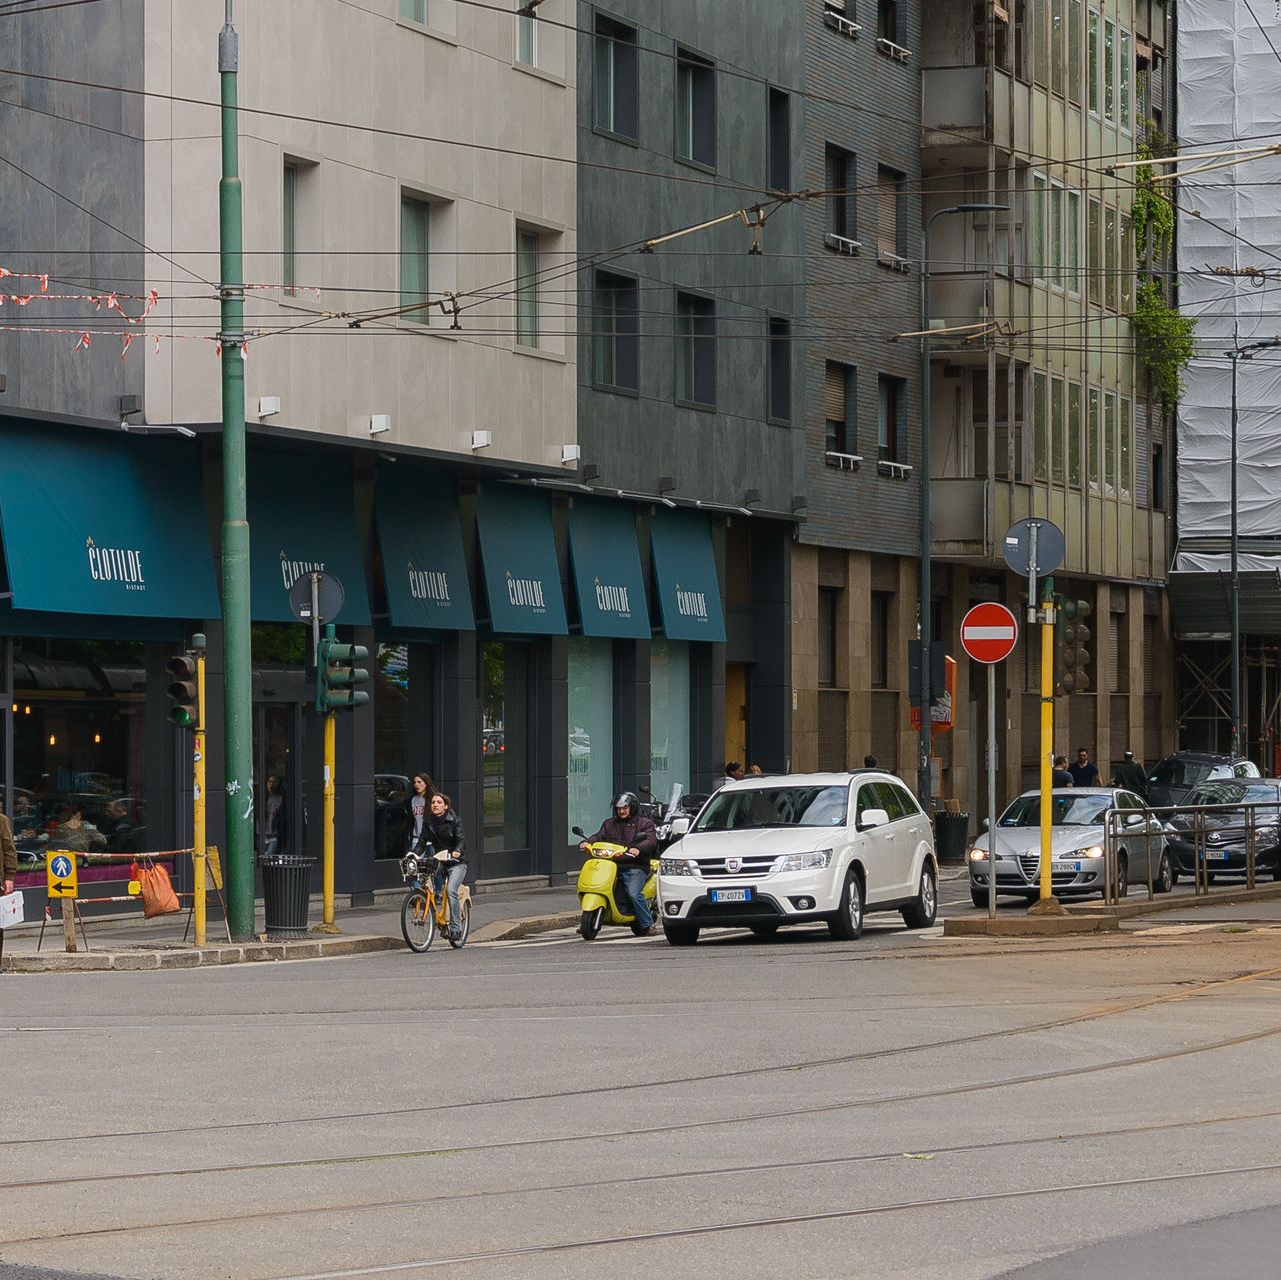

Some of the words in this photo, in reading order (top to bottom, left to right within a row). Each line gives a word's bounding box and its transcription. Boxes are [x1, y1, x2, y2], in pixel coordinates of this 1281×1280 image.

[88, 547, 145, 583] CLOTILDE
[409, 570, 451, 601] CLOTILDE
[507, 578, 546, 607] CLOTILDE
[595, 585, 631, 612] CLOTILDE
[676, 590, 708, 617] CLOTILDE
